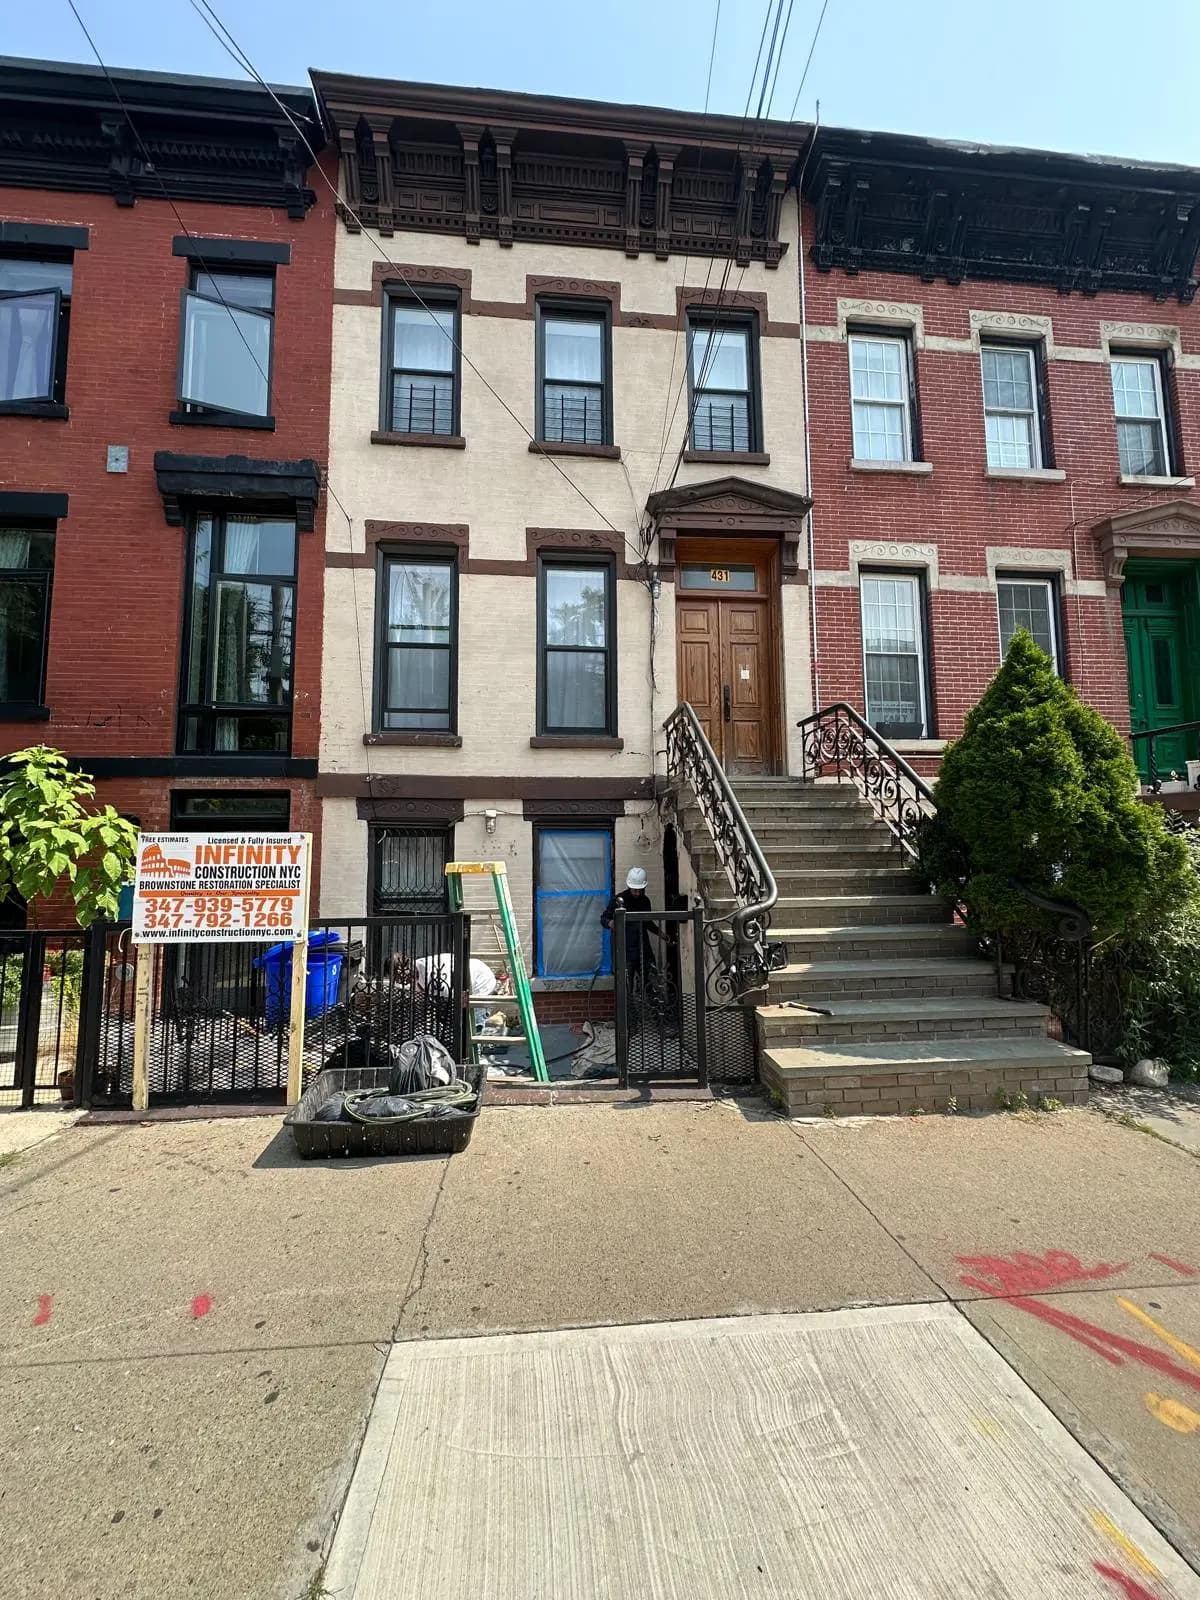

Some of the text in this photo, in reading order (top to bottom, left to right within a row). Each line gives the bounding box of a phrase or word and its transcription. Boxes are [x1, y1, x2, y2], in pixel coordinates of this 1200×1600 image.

[711, 570, 728, 581] 431
[207, 836, 239, 845] Licensed
[240, 837, 246, 845] &
[248, 837, 265, 845] Fully
[195, 845, 302, 865] INFINITY
[195, 865, 301, 879] CONSTRUCTION NYC
[139, 879, 301, 890] BROWNSTONE RESTORATION SPECIALIST
[145, 897, 293, 913] 347-939-5779
[144, 913, 292, 928] 347-792-1266
[142, 928, 294, 938] www.infinityconstructionnyc.com
